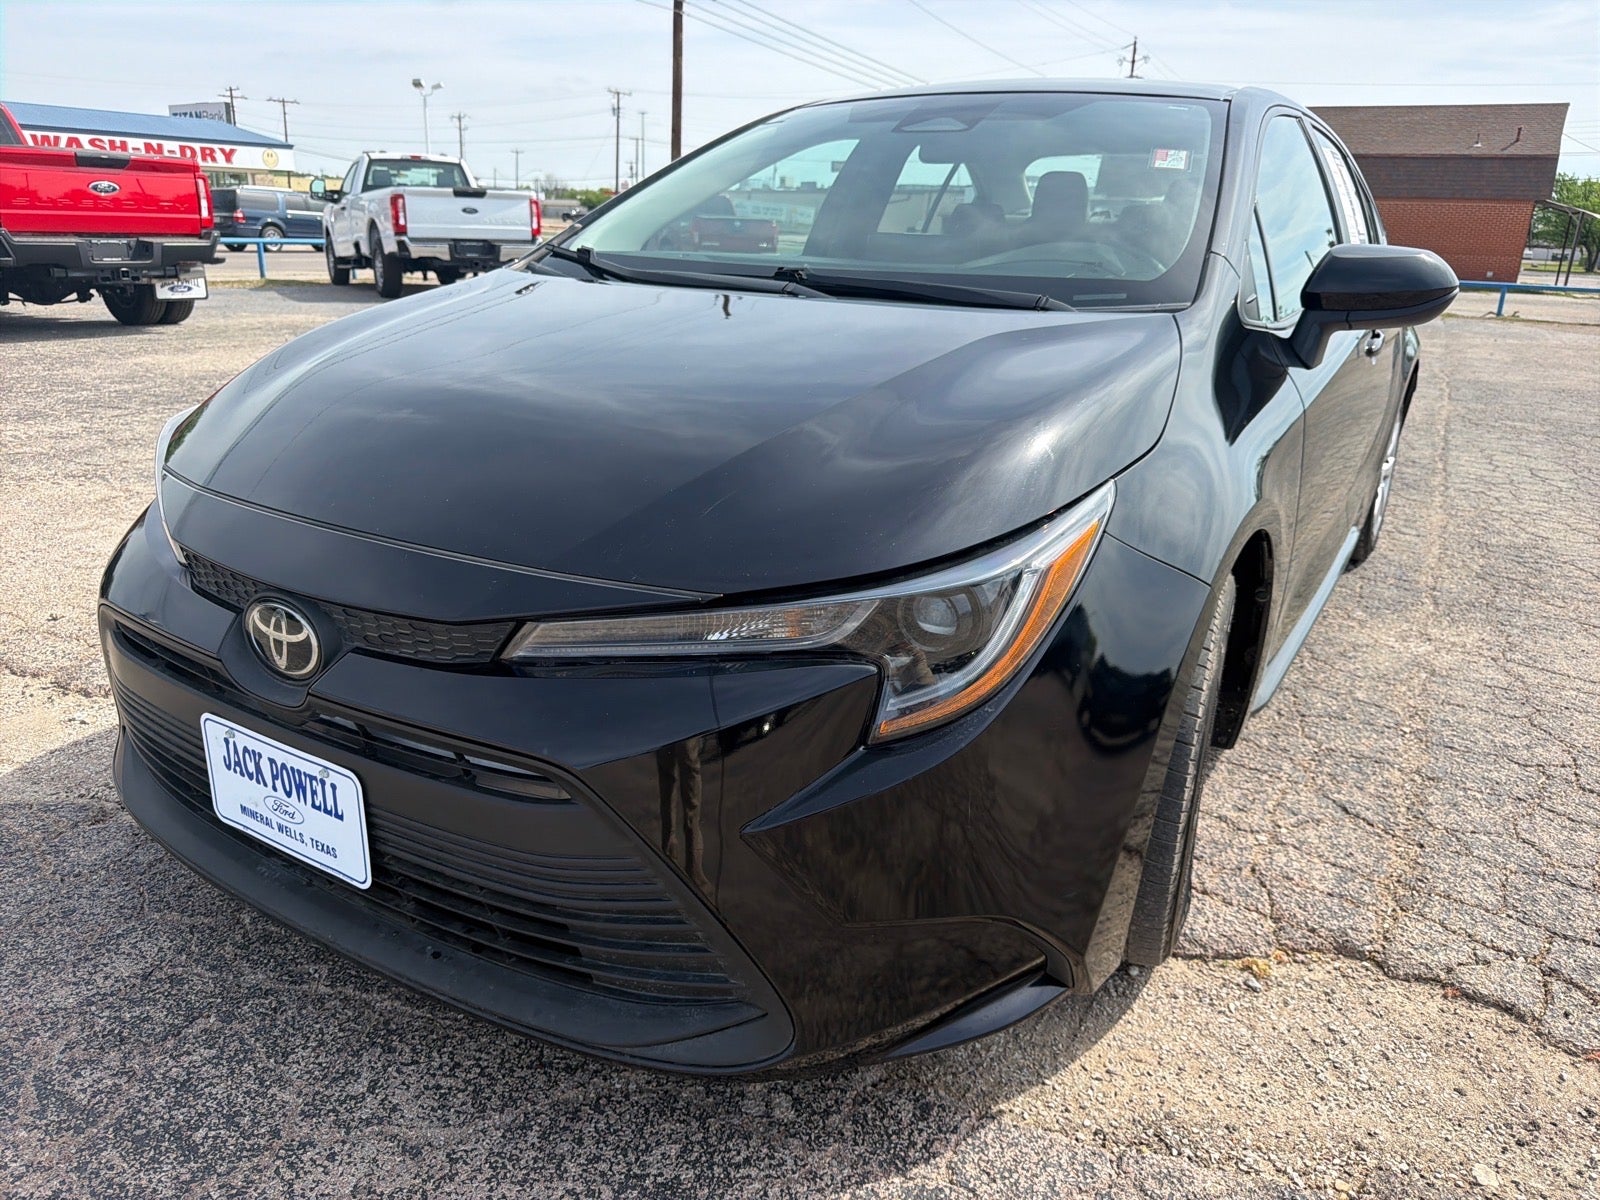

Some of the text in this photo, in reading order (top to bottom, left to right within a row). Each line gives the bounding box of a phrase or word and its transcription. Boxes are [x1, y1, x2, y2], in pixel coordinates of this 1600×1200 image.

[223, 737, 344, 822] JACK POWELL
[240, 803, 338, 859] MINERAL WELLS, TEXAS
[271, 799, 297, 820] Ford
